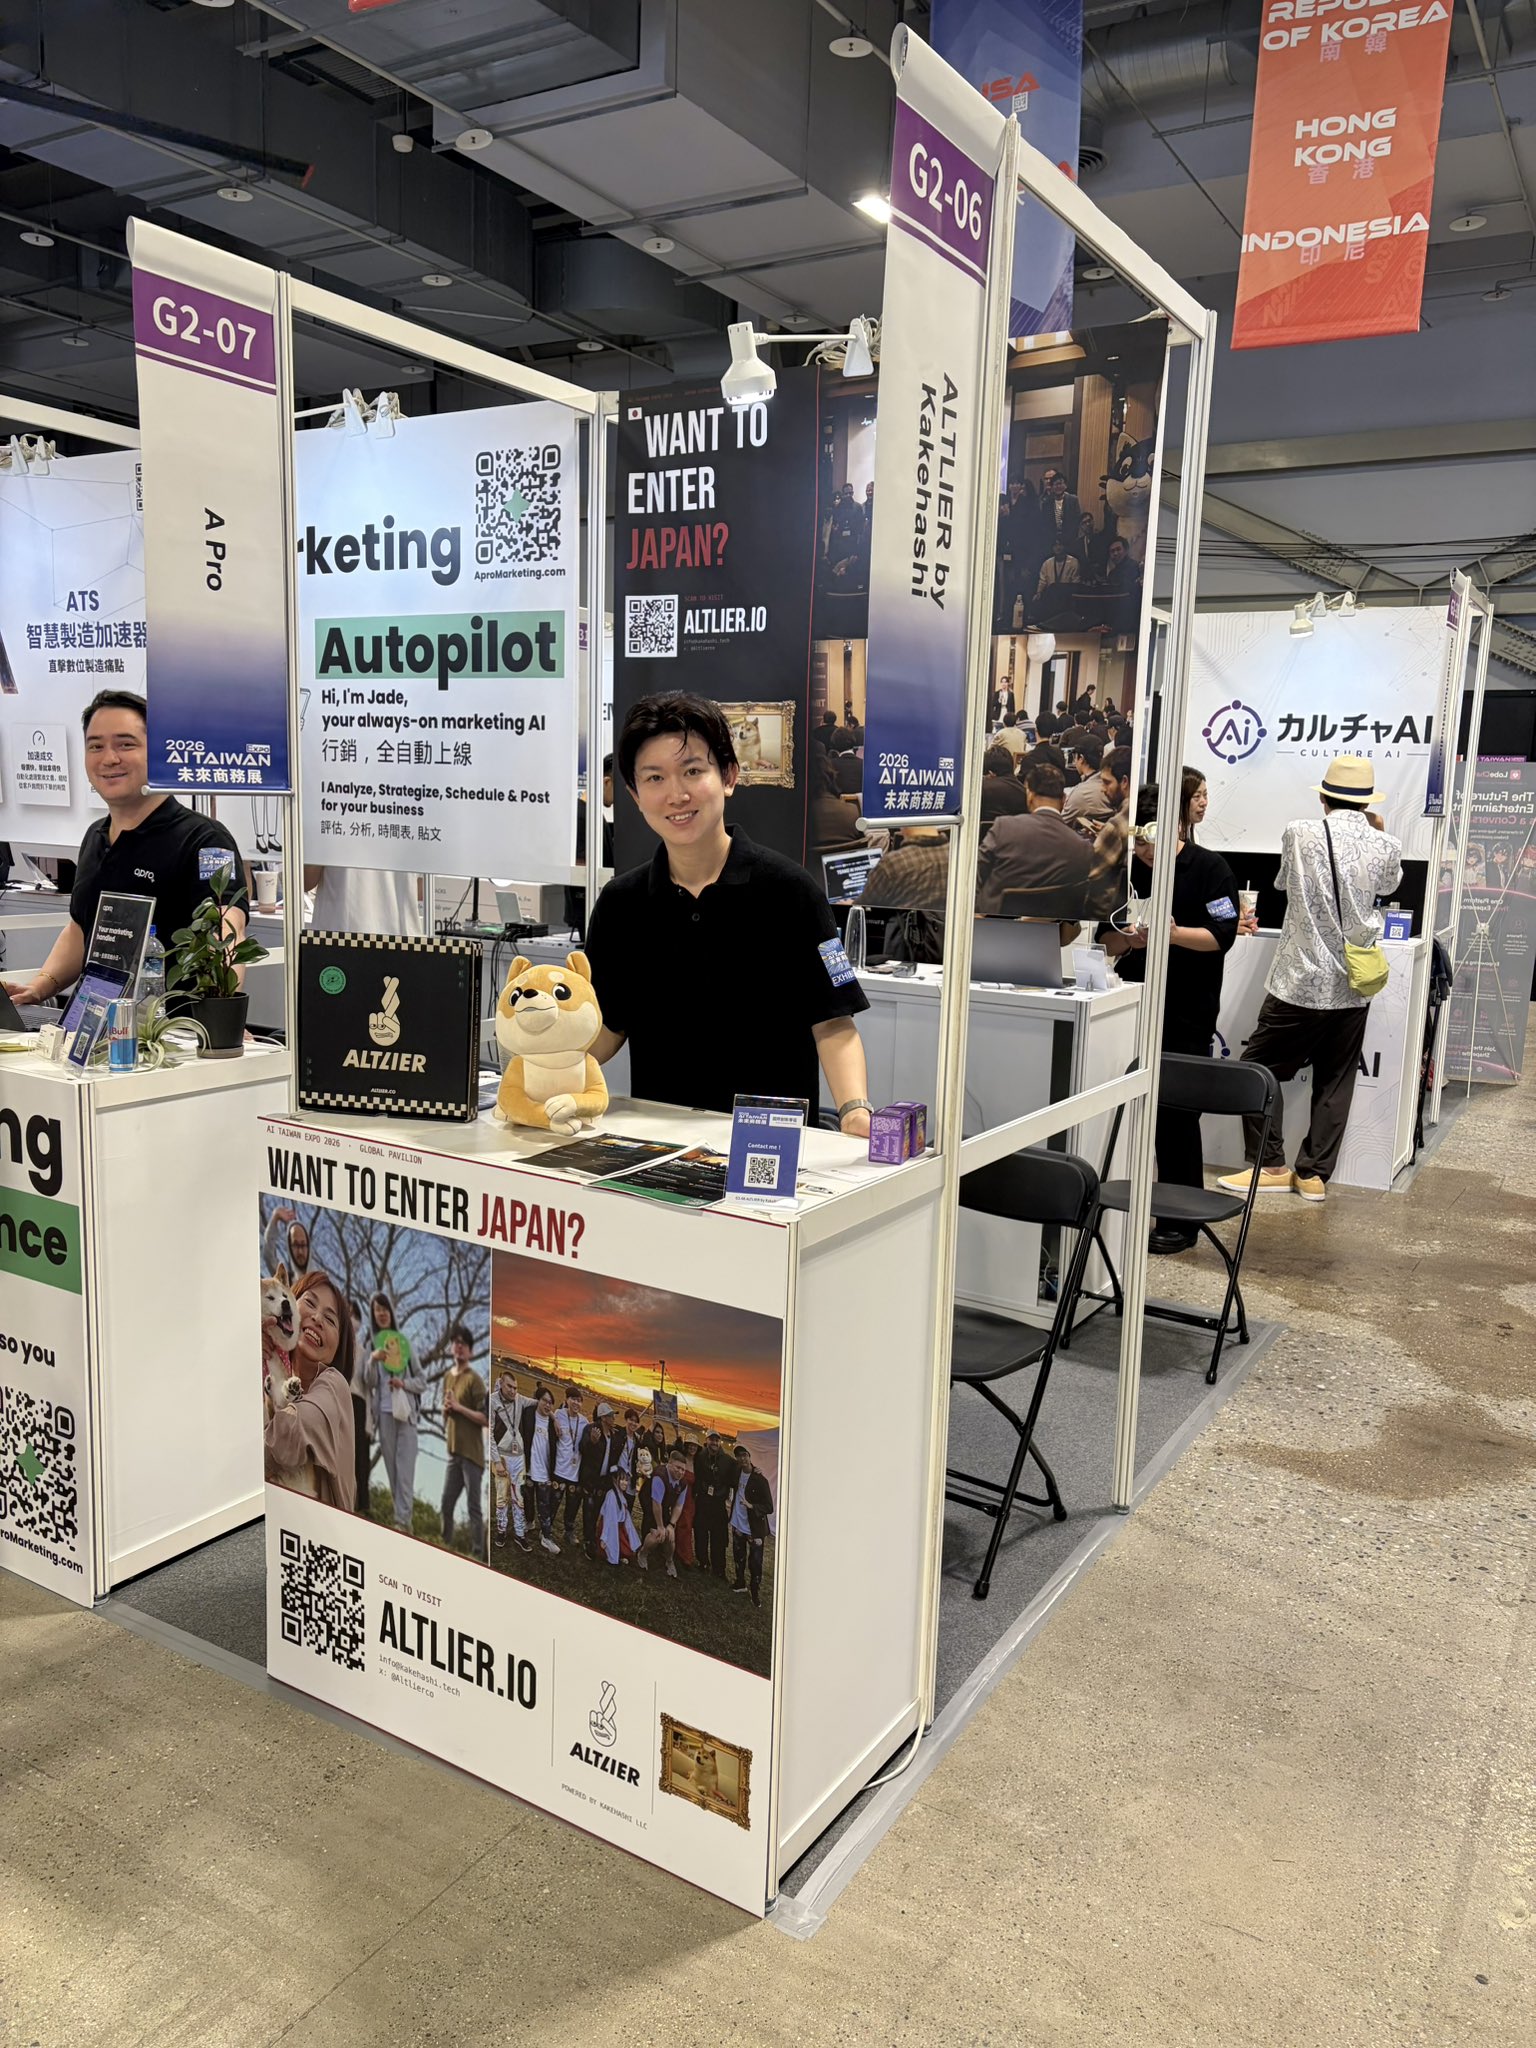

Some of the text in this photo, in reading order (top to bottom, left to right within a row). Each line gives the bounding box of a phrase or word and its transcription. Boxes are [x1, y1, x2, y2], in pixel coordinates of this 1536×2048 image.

[1263, 0, 1449, 50] OF KOREA
[1294, 107, 1397, 140] HONG
[1294, 135, 1393, 167] KONG
[1307, 157, 1375, 185] 香港
[908, 142, 983, 241] G2-06
[1241, 211, 1430, 254] INDONESIA
[152, 295, 257, 361] G2-07
[644, 402, 768, 459] WANT TO
[627, 466, 716, 514] ENTER
[911, 382, 937, 598] Kakehashi
[930, 371, 960, 611] ALTLIER by
[204, 507, 227, 592] A Pro
[626, 522, 730, 570] JAPAN?
[474, 567, 567, 582] AproMarketing.com
[66, 590, 100, 612] ATS
[26, 620, 147, 650] 智慧製造加速器
[683, 606, 768, 635] ALTLIER.IO
[318, 615, 557, 692] Autopilot
[321, 689, 408, 708] Hi, I'm Jade,
[321, 712, 546, 736] your always-on marketing AI
[1277, 713, 1434, 745] カルチャAI
[165, 739, 205, 751] 2026
[166, 750, 271, 767] AI TAIWAN
[878, 752, 909, 768] 2026
[1384, 750, 1401, 759] AI
[177, 766, 263, 784] 未來商務展
[878, 767, 954, 787] AI TAIWAN
[320, 798, 424, 817] for your business
[326, 781, 377, 798] Analyze,
[378, 783, 443, 802] Strategize,
[445, 786, 505, 802] Schedule
[507, 789, 517, 802] &
[520, 789, 551, 804] Post
[884, 789, 947, 810] 未來商務展
[266, 1125, 423, 1166] AI TAIWAN EXPO 2026 GLOBAL PAVILION
[747, 1142, 768, 1150] Contact
[267, 1146, 585, 1260] WANT TO ENTER JAPAN?
[20, 1340, 56, 1368] you
[378, 1574, 443, 1608] SCAN TO VISIT
[379, 1599, 537, 1710] ALTLIER.IO
[379, 1653, 461, 1697] info@kakehashi.tech
[391, 1672, 435, 1699] @Altlierco
[569, 1742, 641, 1788] ALTLIER
[561, 1783, 587, 1801] POWERED
[600, 1803, 633, 1823] KAKEHASHI
[636, 1818, 648, 1831] LLC
